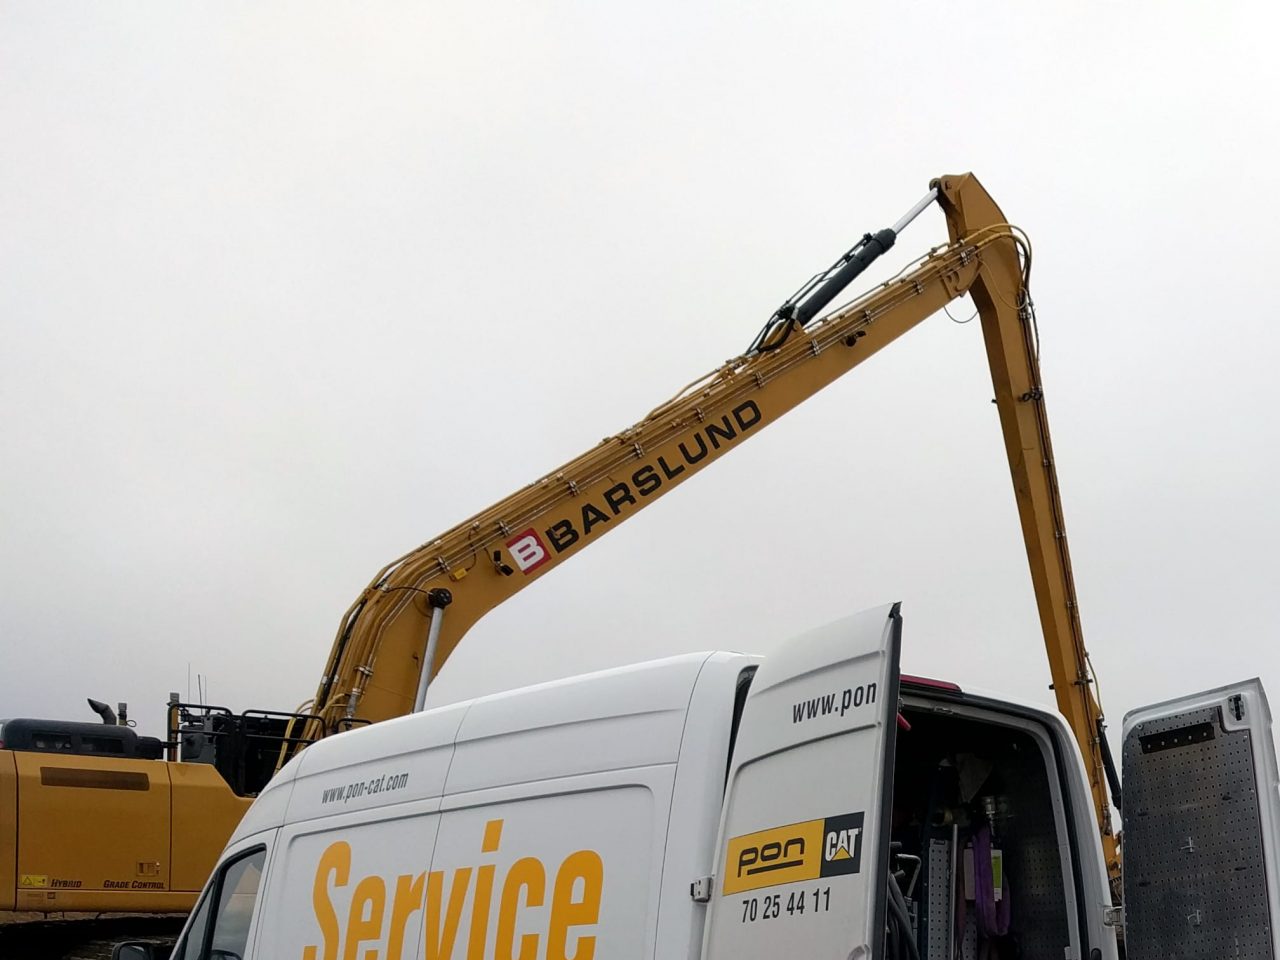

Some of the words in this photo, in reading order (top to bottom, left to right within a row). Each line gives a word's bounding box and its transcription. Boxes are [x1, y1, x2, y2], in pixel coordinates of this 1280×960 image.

[545, 400, 762, 553] BARSLUND
[792, 682, 877, 723] www.pon
[322, 773, 408, 804] www.pon-cat.com
[737, 837, 805, 878] pon
[825, 828, 859, 862] CAT
[742, 898, 757, 922] 70
[763, 895, 780, 920] 25
[786, 891, 805, 915] 44
[813, 887, 831, 912] 11
